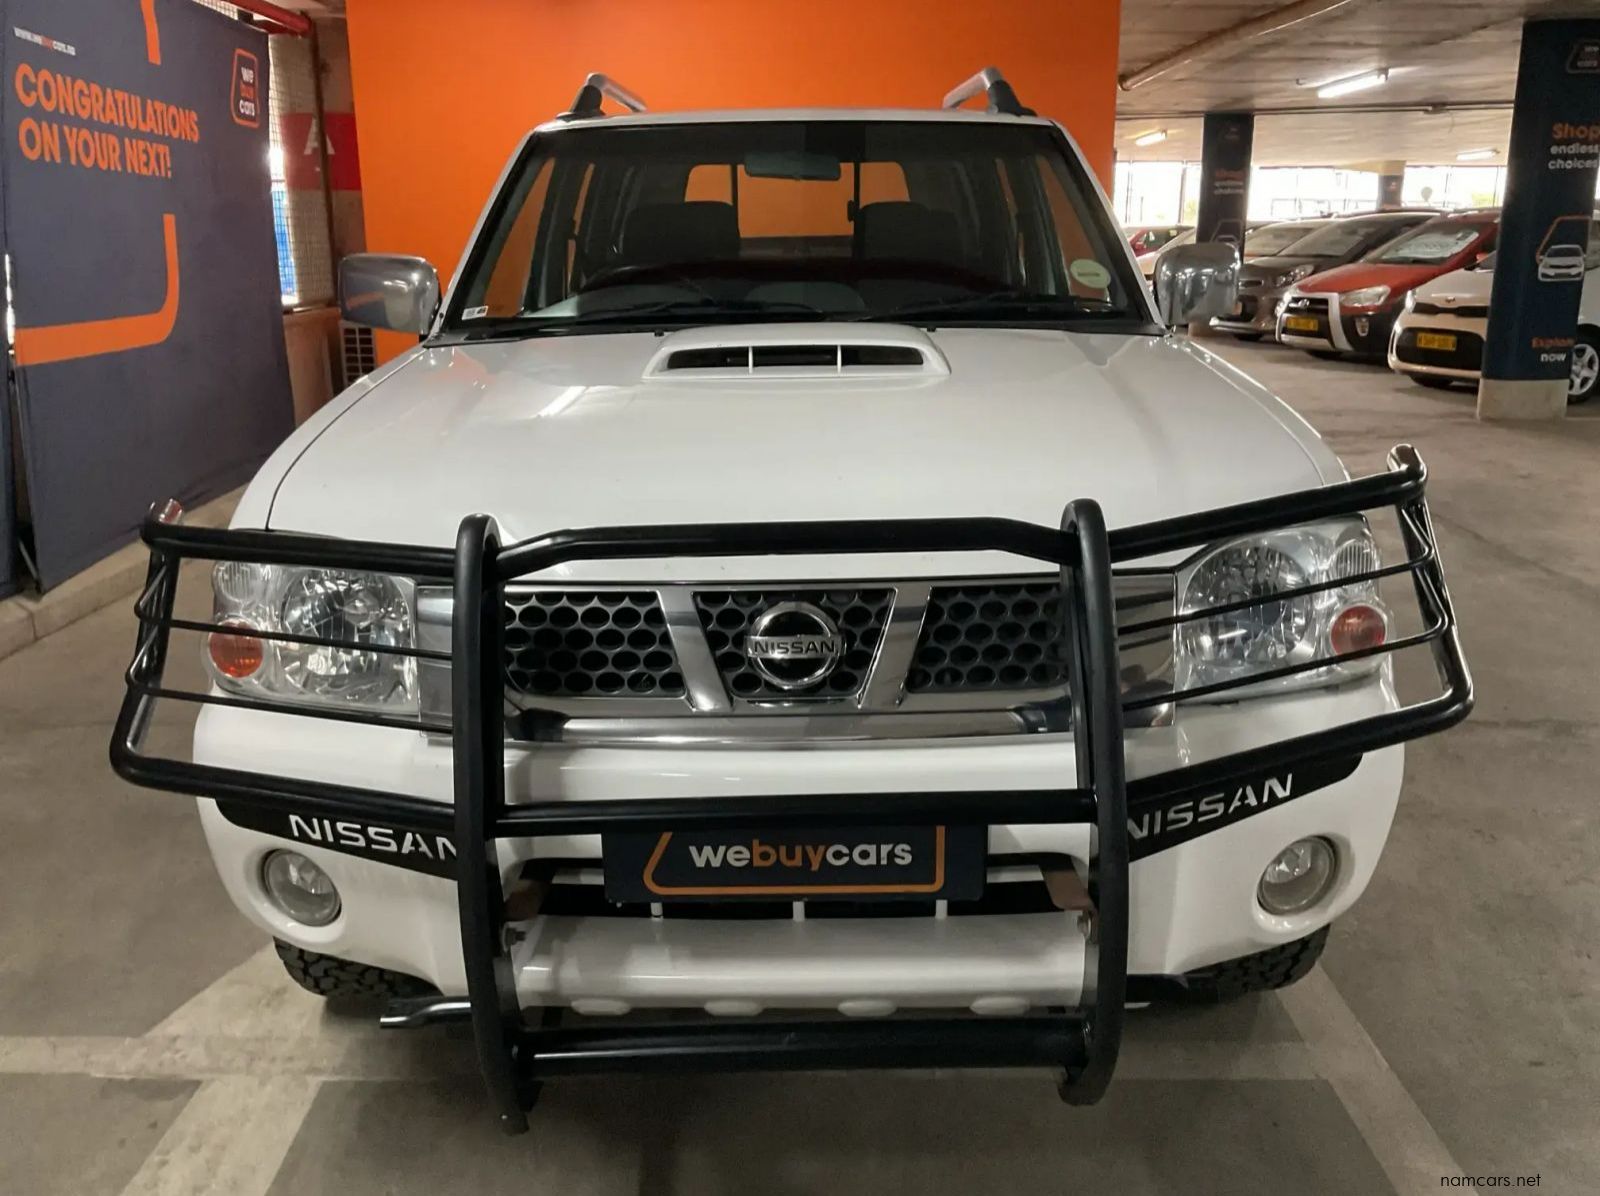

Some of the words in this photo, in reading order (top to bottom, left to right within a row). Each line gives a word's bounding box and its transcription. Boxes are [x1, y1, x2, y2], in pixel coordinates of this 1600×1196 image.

[15, 63, 200, 143] CONGRATULATIONS
[18, 117, 62, 164] ON
[64, 126, 122, 172] YOUR
[124, 137, 172, 179] NEXT!
[1540, 352, 1567, 362] now
[754, 640, 836, 655] NISSAN
[688, 838, 914, 872] webuycars
